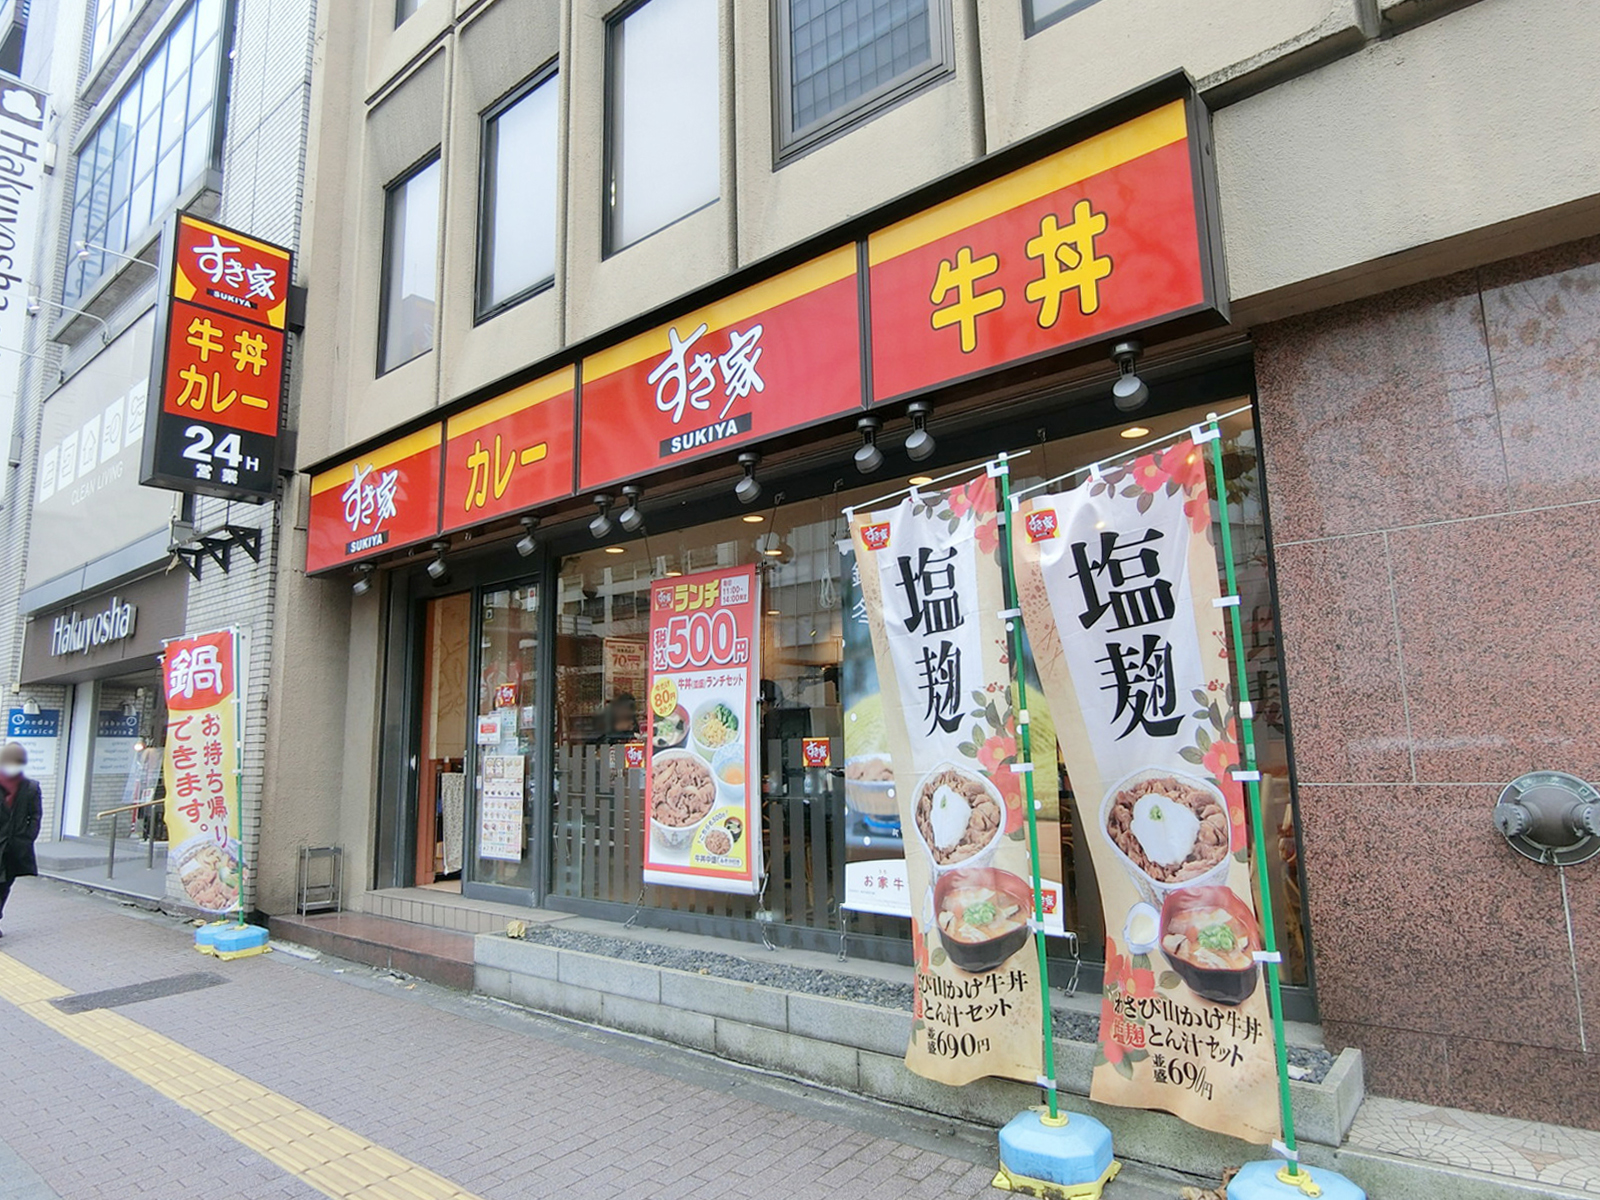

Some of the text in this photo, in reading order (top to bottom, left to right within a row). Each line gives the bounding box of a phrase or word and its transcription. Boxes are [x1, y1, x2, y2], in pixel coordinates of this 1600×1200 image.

[193, 235, 276, 301] すき家
[930, 199, 1114, 353] 牛丼
[213, 290, 252, 308] SUKIYA
[187, 317, 268, 376] 牛丼
[176, 364, 269, 413] カレー
[647, 323, 765, 423] すき家
[182, 425, 259, 472] 24H
[671, 419, 738, 453] SUKIYA
[195, 463, 240, 485] 営業
[341, 463, 398, 533] すき家
[464, 434, 548, 512] カレー
[350, 533, 383, 553] SUKIYA
[675, 579, 720, 612] ランチ
[51, 597, 134, 656] Hakuyosha
[653, 608, 749, 671] 税込 500円
[170, 645, 223, 700] 鍋
[654, 689, 676, 708] 80円
[13, 727, 54, 735] Service
[201, 713, 228, 849] お持ち帰り
[924, 998, 1012, 1028] とん汁セット
[1114, 993, 1263, 1044] わさび山かけ牛丼
[1153, 1053, 1168, 1084] 並盛
